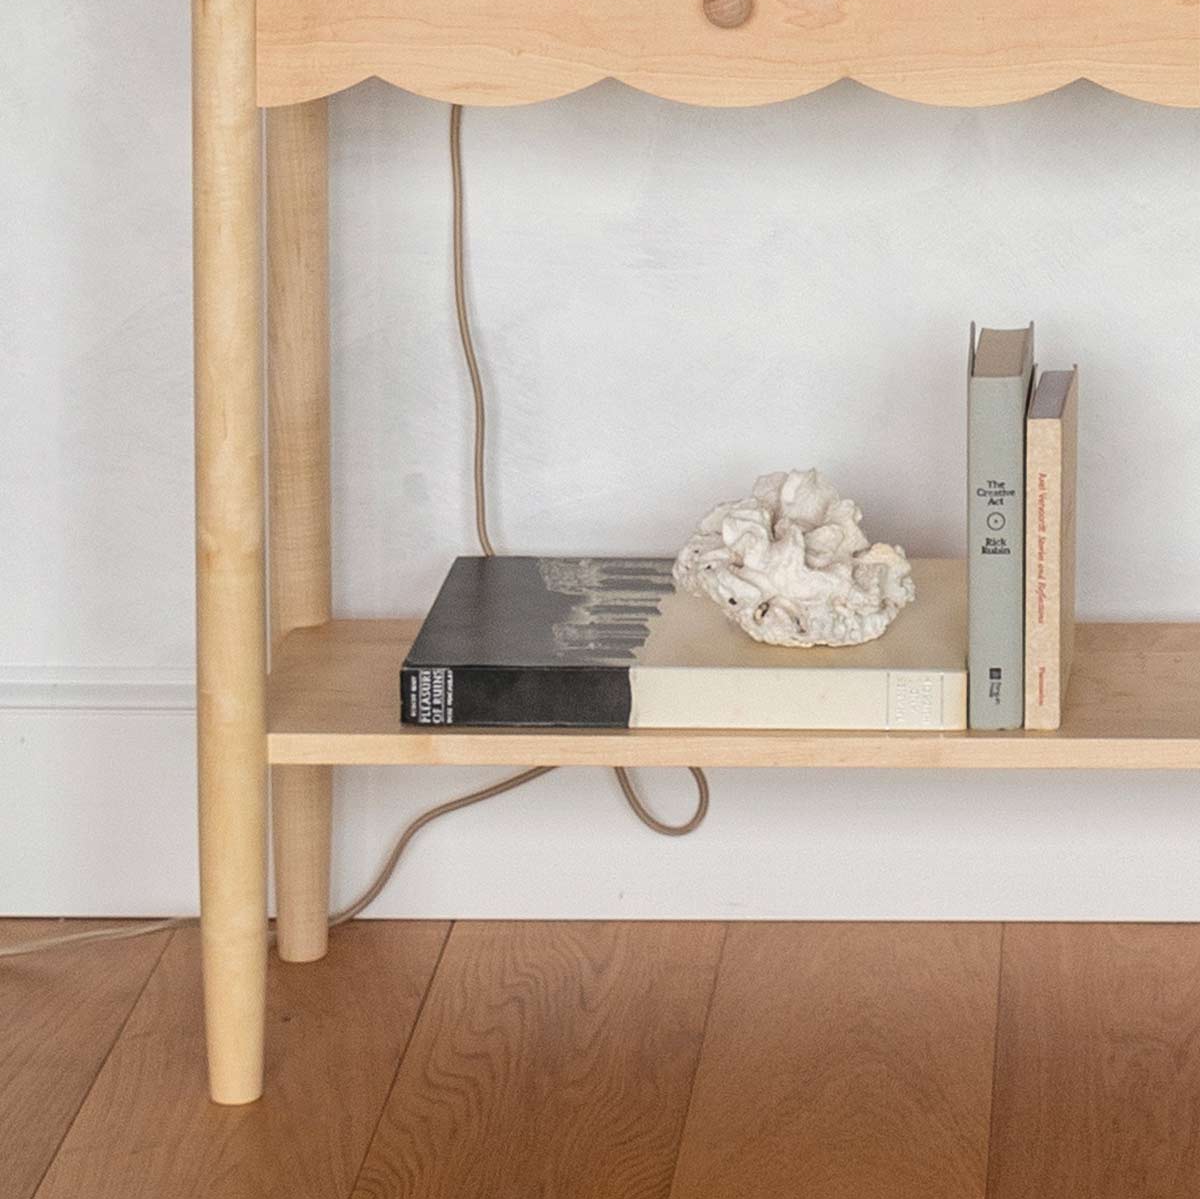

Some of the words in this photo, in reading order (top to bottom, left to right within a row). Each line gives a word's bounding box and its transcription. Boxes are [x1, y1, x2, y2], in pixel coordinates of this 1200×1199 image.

[987, 480, 1005, 488] The
[976, 488, 1015, 497] Creative
[987, 497, 1004, 506] Act
[986, 537, 1006, 546] Rick
[981, 545, 1011, 554] Rubin
